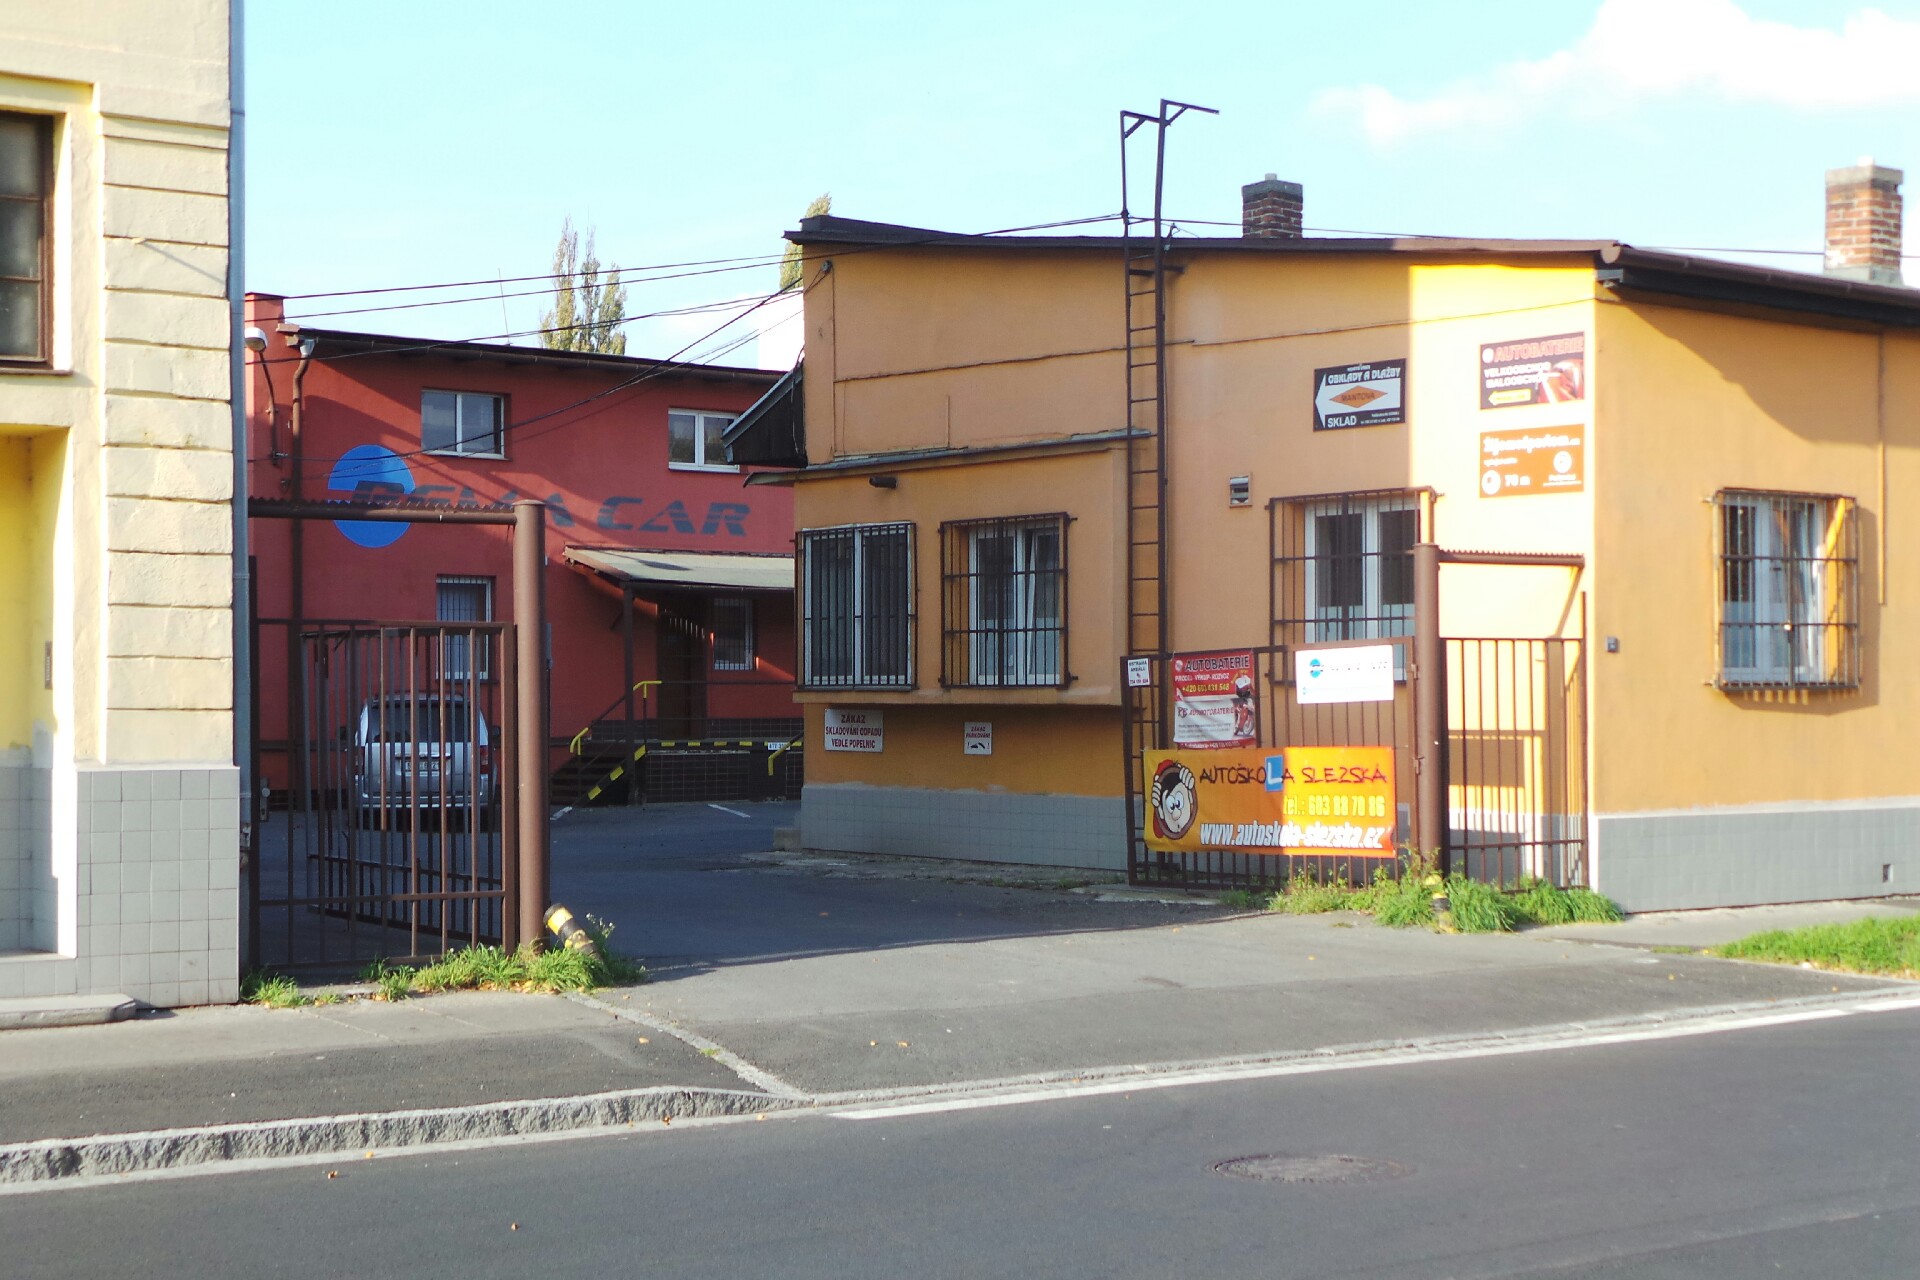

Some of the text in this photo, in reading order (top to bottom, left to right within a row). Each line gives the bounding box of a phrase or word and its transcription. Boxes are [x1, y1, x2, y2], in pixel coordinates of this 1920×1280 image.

[1494, 337, 1583, 362] AUTOBATERIE
[1328, 372, 1362, 384] OBKLADY
[1364, 371, 1370, 380] A
[1372, 367, 1401, 379] DLAŽBY
[1342, 392, 1375, 401] MANTOVA
[1327, 415, 1357, 428] SKLAD
[596, 495, 752, 537] CAR
[1185, 656, 1250, 671] AUTOBATERIE
[841, 713, 866, 724] ZÁKAZ
[831, 738, 875, 749] VEDLE POPELNIC
[1200, 762, 1294, 785] AUTOŠKOLA
[1283, 795, 1305, 815] tel.:
[1308, 795, 1330, 816] 603
[1352, 796, 1366, 816] 70
[1368, 796, 1386, 817] 86
[1201, 820, 1385, 849] www.autoskola-slezska.cz
